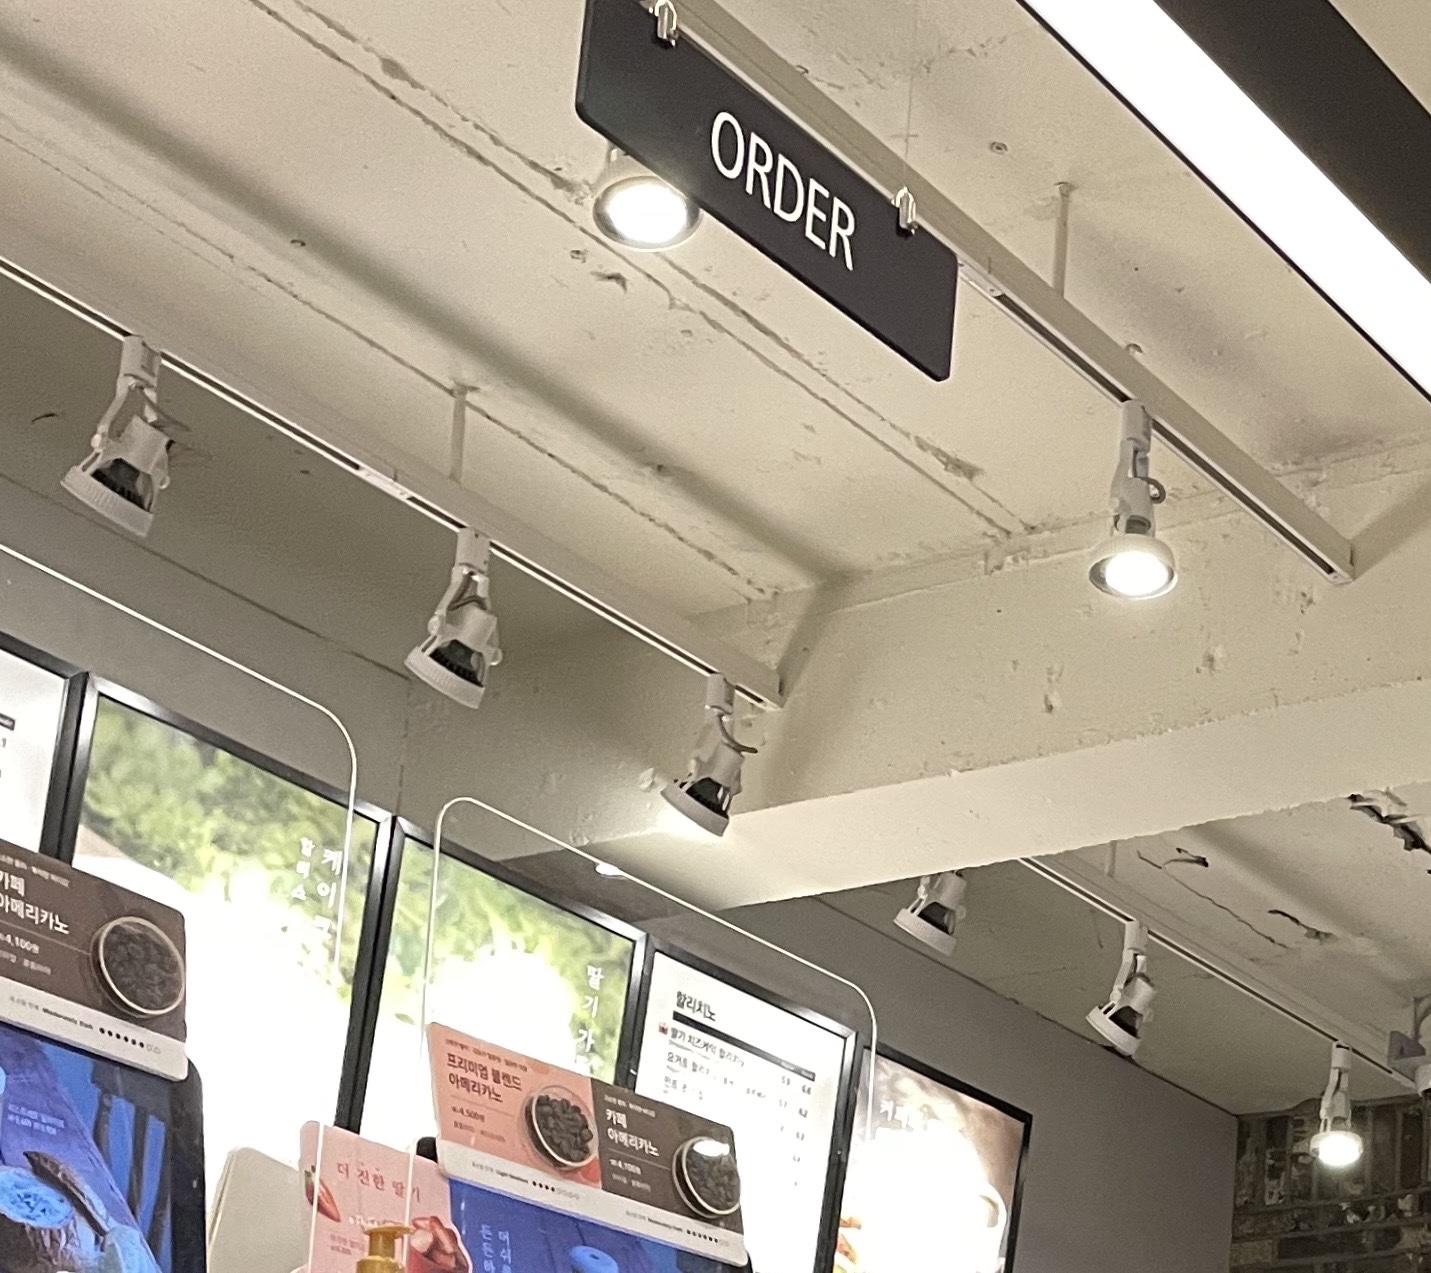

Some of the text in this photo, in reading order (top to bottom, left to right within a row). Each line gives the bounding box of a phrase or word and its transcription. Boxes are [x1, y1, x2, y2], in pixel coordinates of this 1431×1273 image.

[710, 111, 856, 272] ORDER
[0, 896, 70, 936] 아메리카노
[676, 990, 717, 1022] 할리치노
[446, 1052, 489, 1081] 프리미엄
[491, 1067, 523, 1092] 블렌드
[448, 1072, 504, 1103] 아메리카노
[605, 1108, 628, 1129] 카페
[607, 1127, 660, 1157] 아메리카노
[337, 1162, 349, 1179] 더
[357, 1161, 385, 1191] 진한
